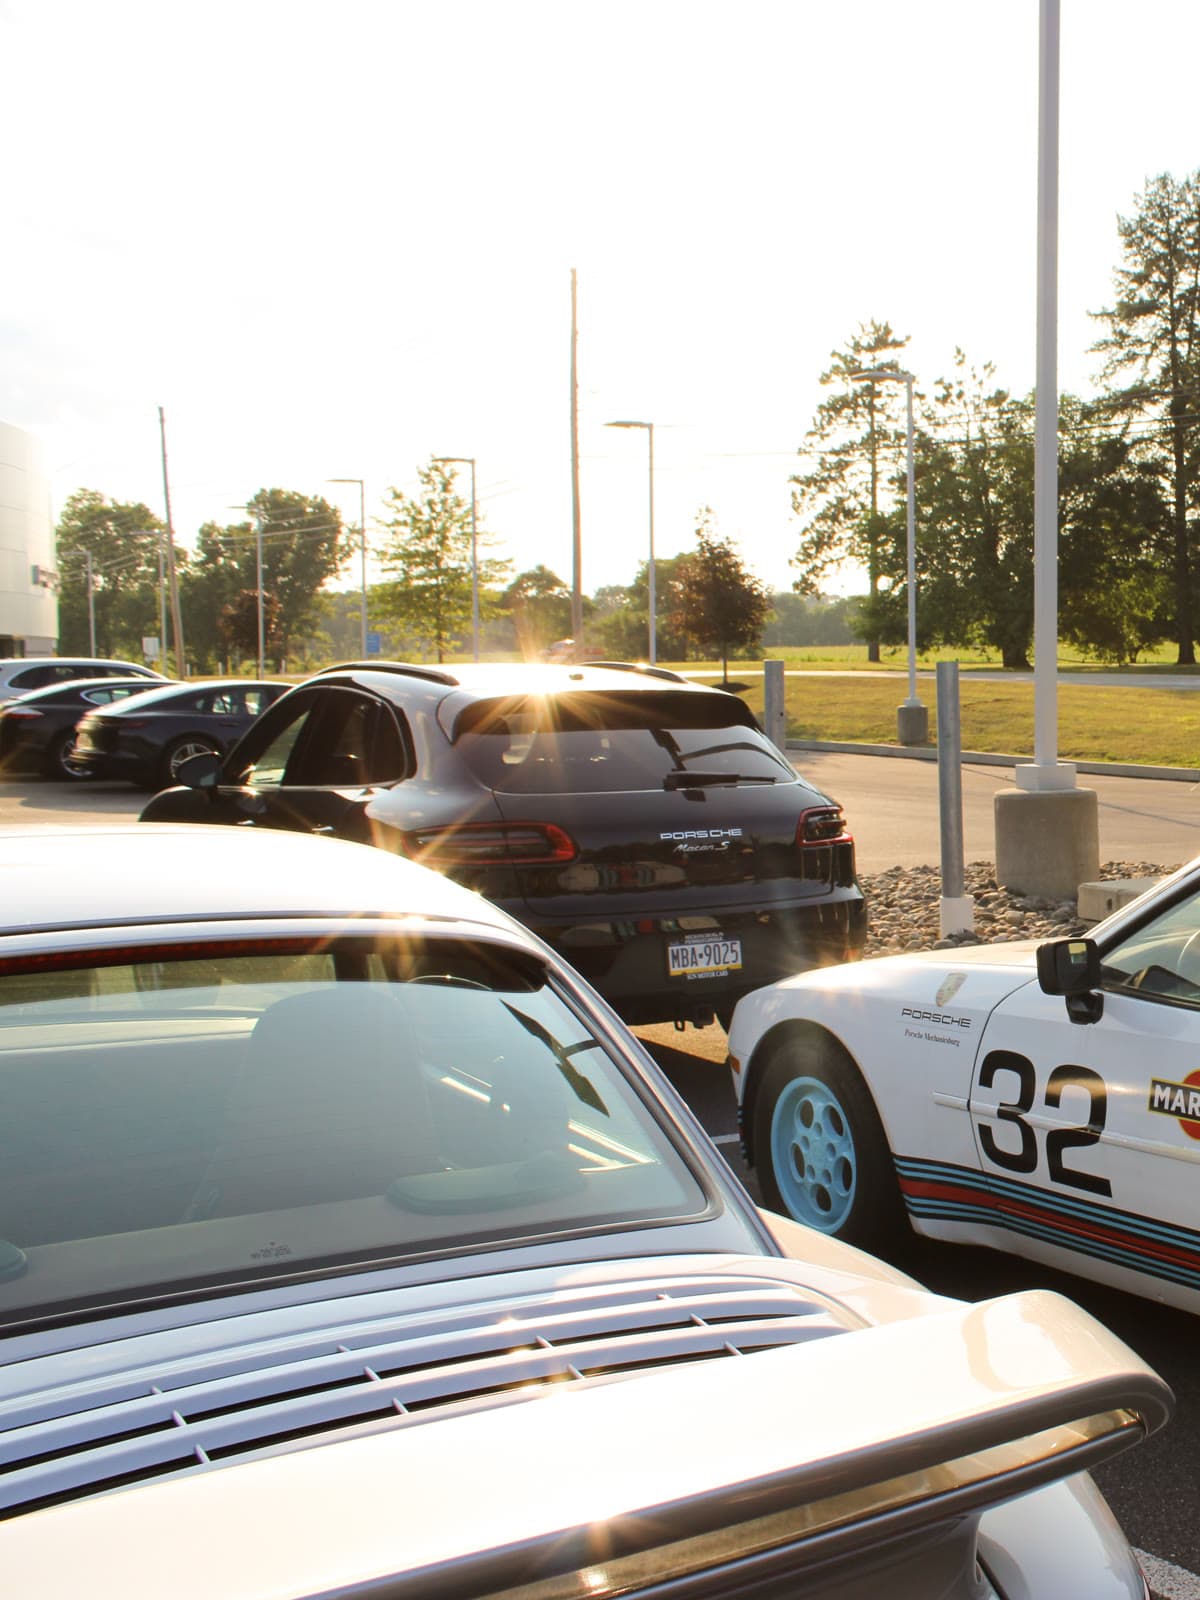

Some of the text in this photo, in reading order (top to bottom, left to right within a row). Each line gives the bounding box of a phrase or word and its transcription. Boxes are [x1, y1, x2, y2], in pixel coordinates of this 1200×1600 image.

[660, 828, 743, 840] PORSCHE
[673, 840, 730, 852] Macan S
[901, 1008, 972, 1028] PORSCHE
[978, 1049, 1112, 1198] 32
